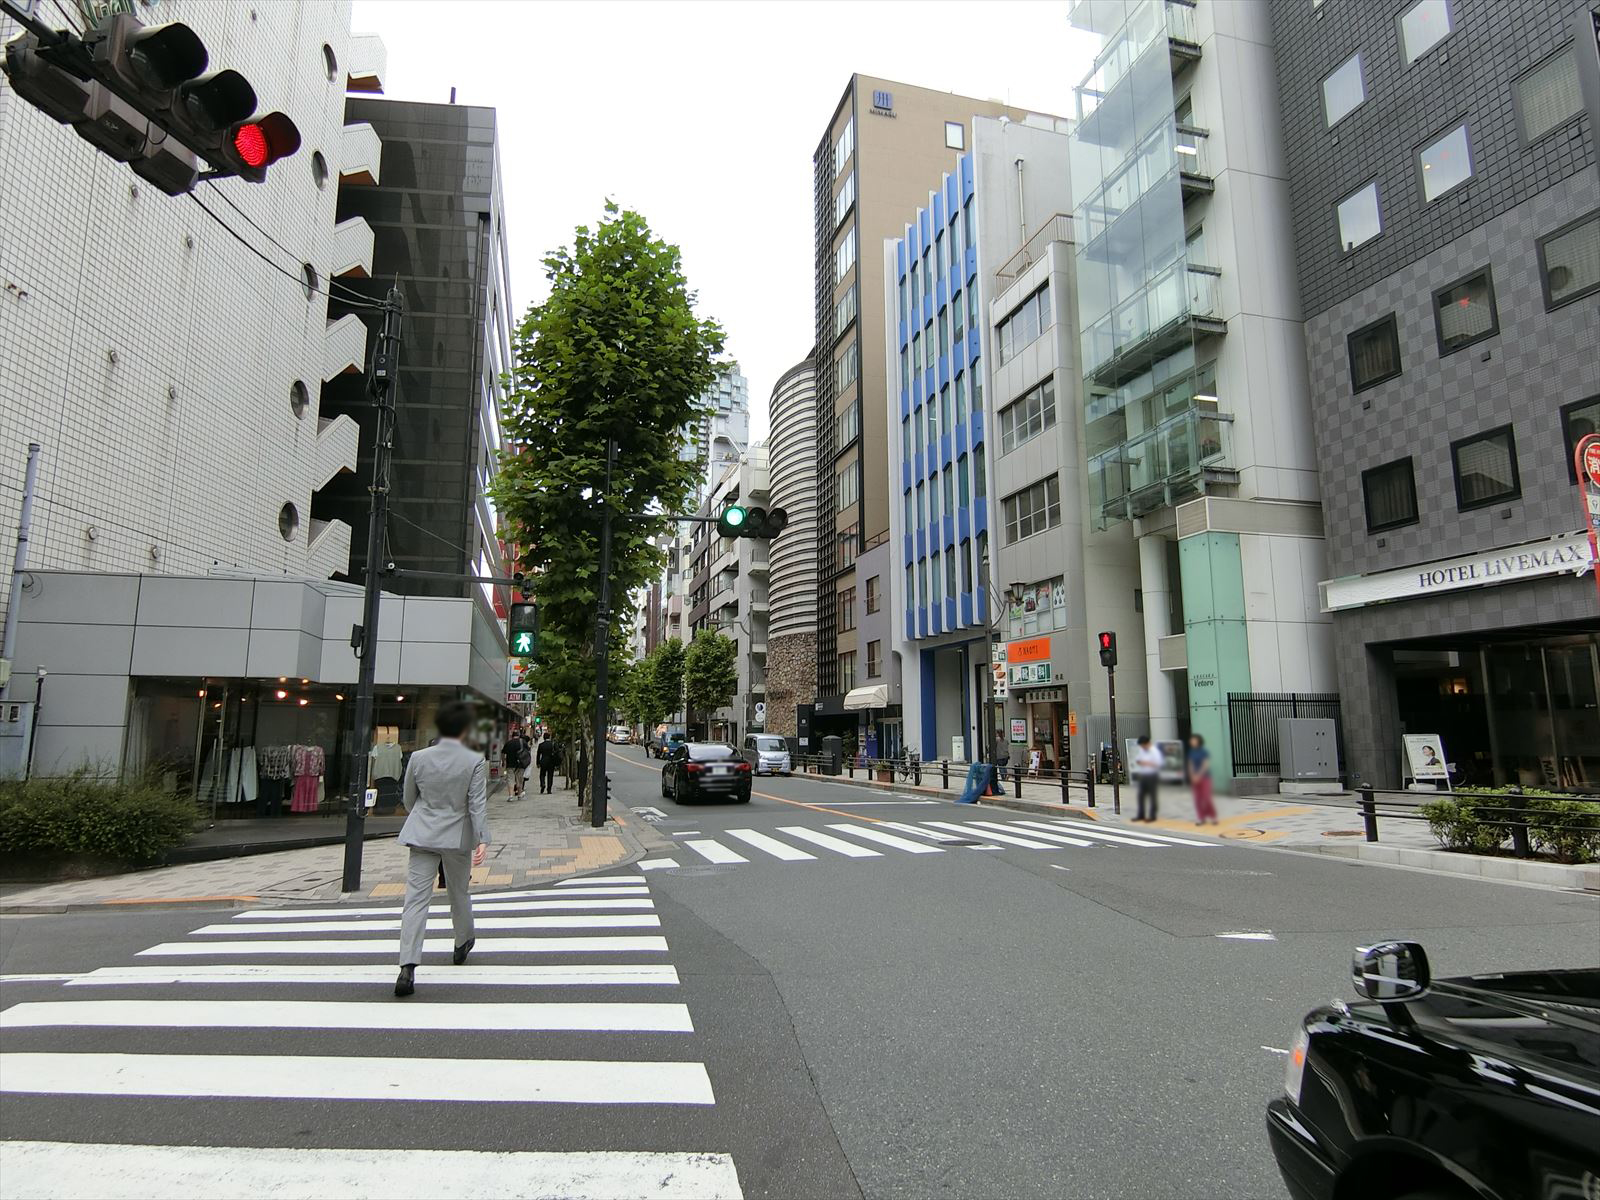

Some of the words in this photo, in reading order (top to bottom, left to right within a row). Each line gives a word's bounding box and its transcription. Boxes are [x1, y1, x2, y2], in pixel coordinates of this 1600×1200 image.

[1587, 455, 1600, 474] 消
[1419, 564, 1480, 588] HOTEL
[1485, 543, 1585, 576] LiVEMAX
[509, 693, 521, 701] ATM
